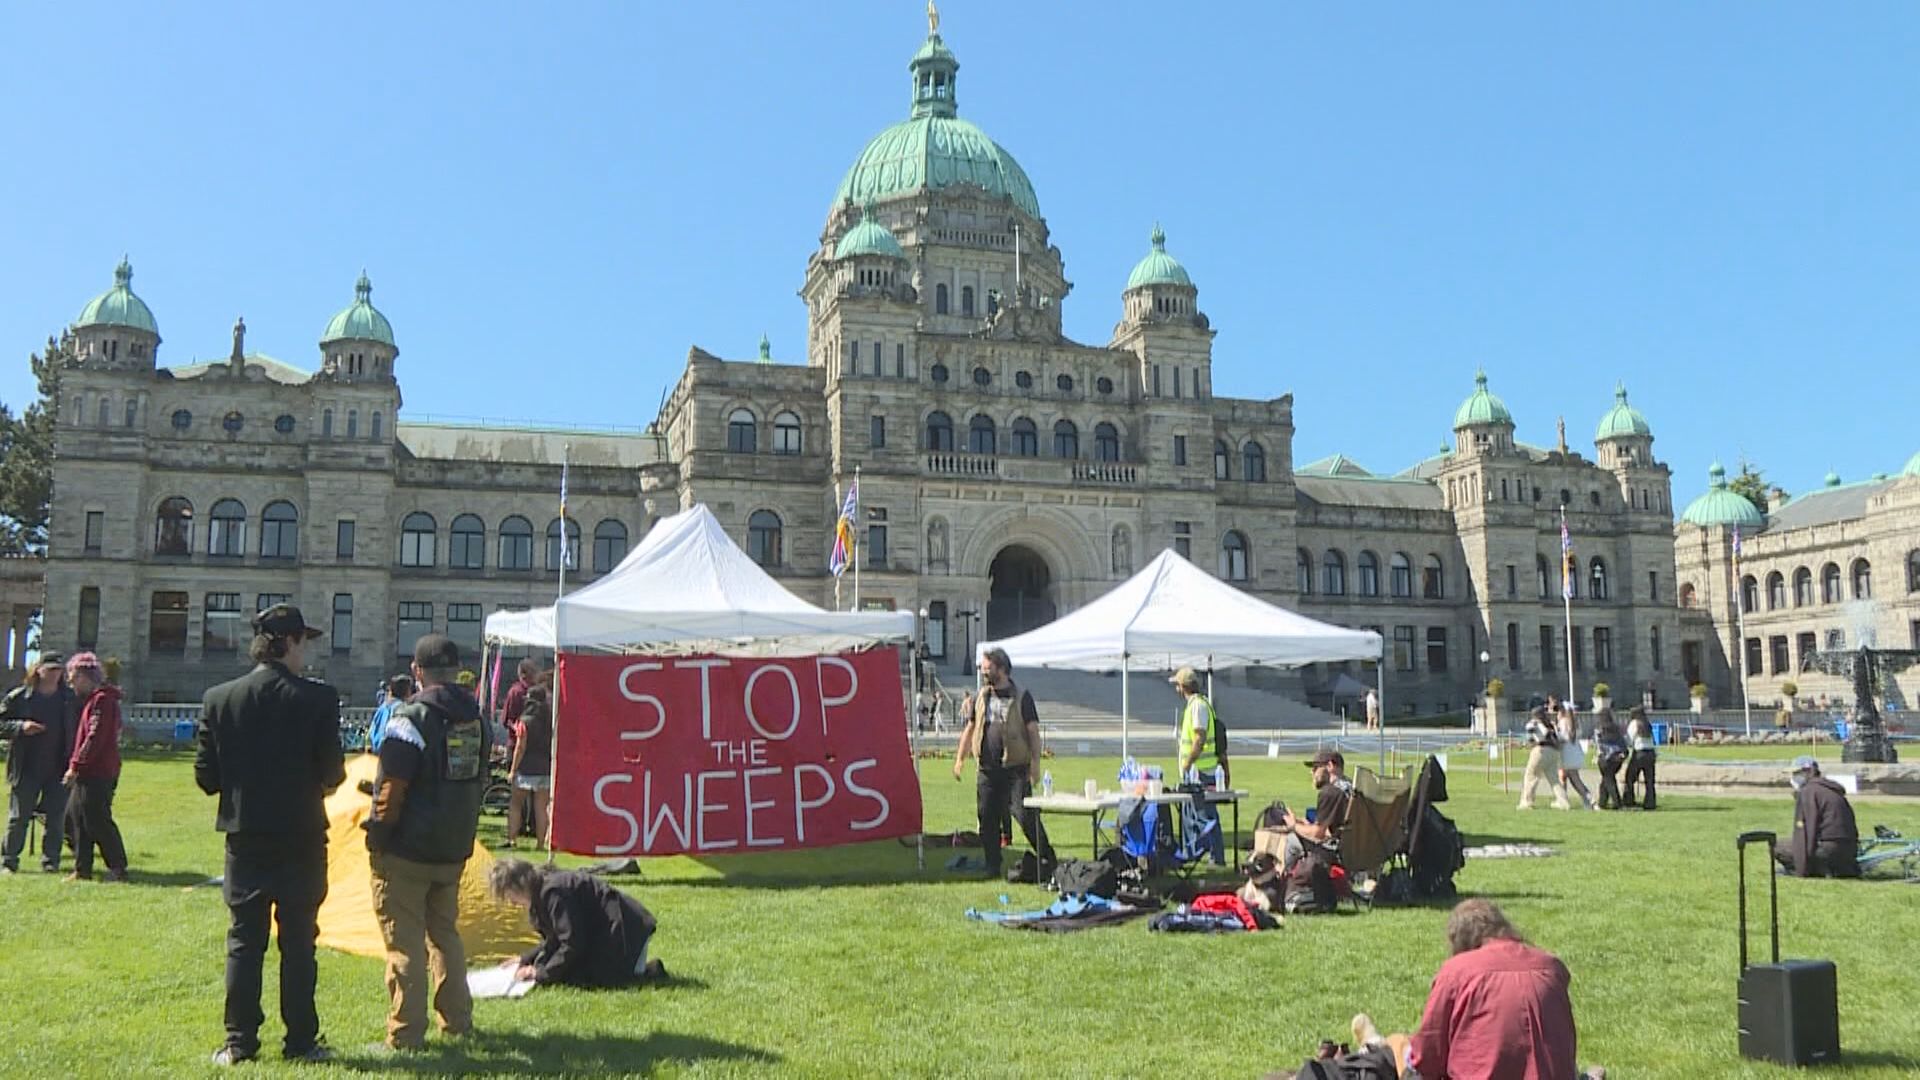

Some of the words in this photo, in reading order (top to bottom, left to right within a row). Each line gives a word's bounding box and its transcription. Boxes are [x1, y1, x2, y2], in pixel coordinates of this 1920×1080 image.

[618, 657, 858, 740] STOP
[711, 739, 768, 765] THE
[593, 758, 890, 855] SWEEPS
